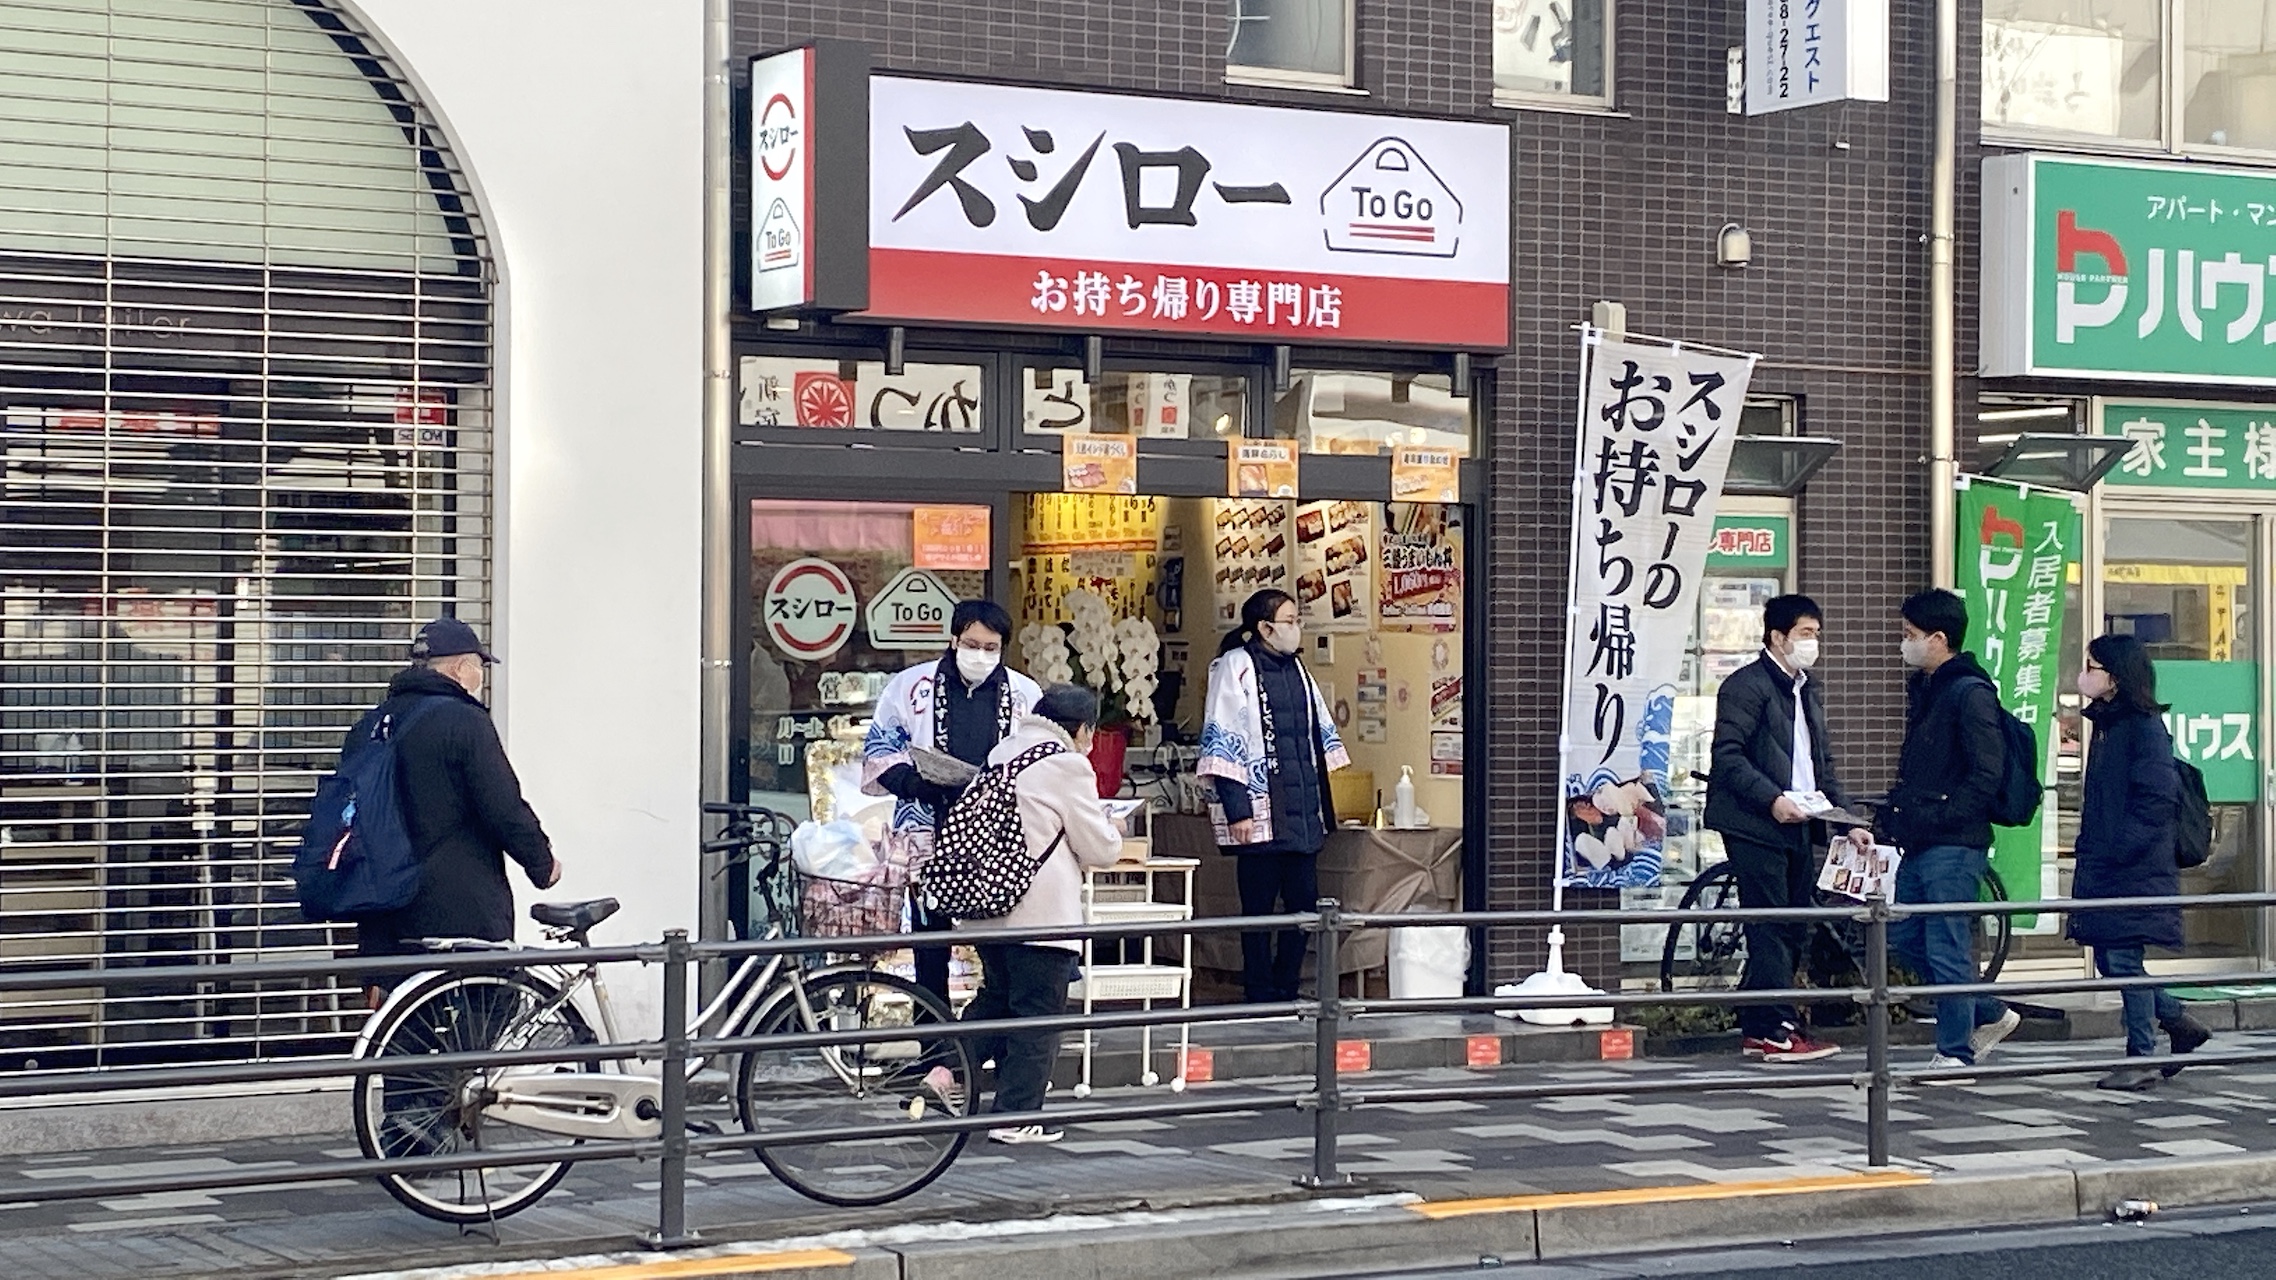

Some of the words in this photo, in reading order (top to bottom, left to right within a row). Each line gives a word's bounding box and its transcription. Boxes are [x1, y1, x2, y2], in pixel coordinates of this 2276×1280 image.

[1779, 0, 1790, 99] 8-27-22
[758, 125, 799, 152] スシロー
[892, 120, 1292, 231] スシロー
[765, 230, 776, 249] To
[778, 229, 791, 247] Go
[1351, 186, 1386, 219] To
[1393, 188, 1434, 222] Go
[1030, 268, 1343, 330] お持ち帰り専門店
[2137, 247, 2276, 346] ハウ
[1642, 371, 1726, 610] スシローの
[1584, 359, 1673, 765] お持ち帰り
[767, 596, 854, 620] スシロー
[890, 602, 913, 621] To
[916, 603, 943, 622] Go
[2011, 520, 2064, 725] 入居者募集中
